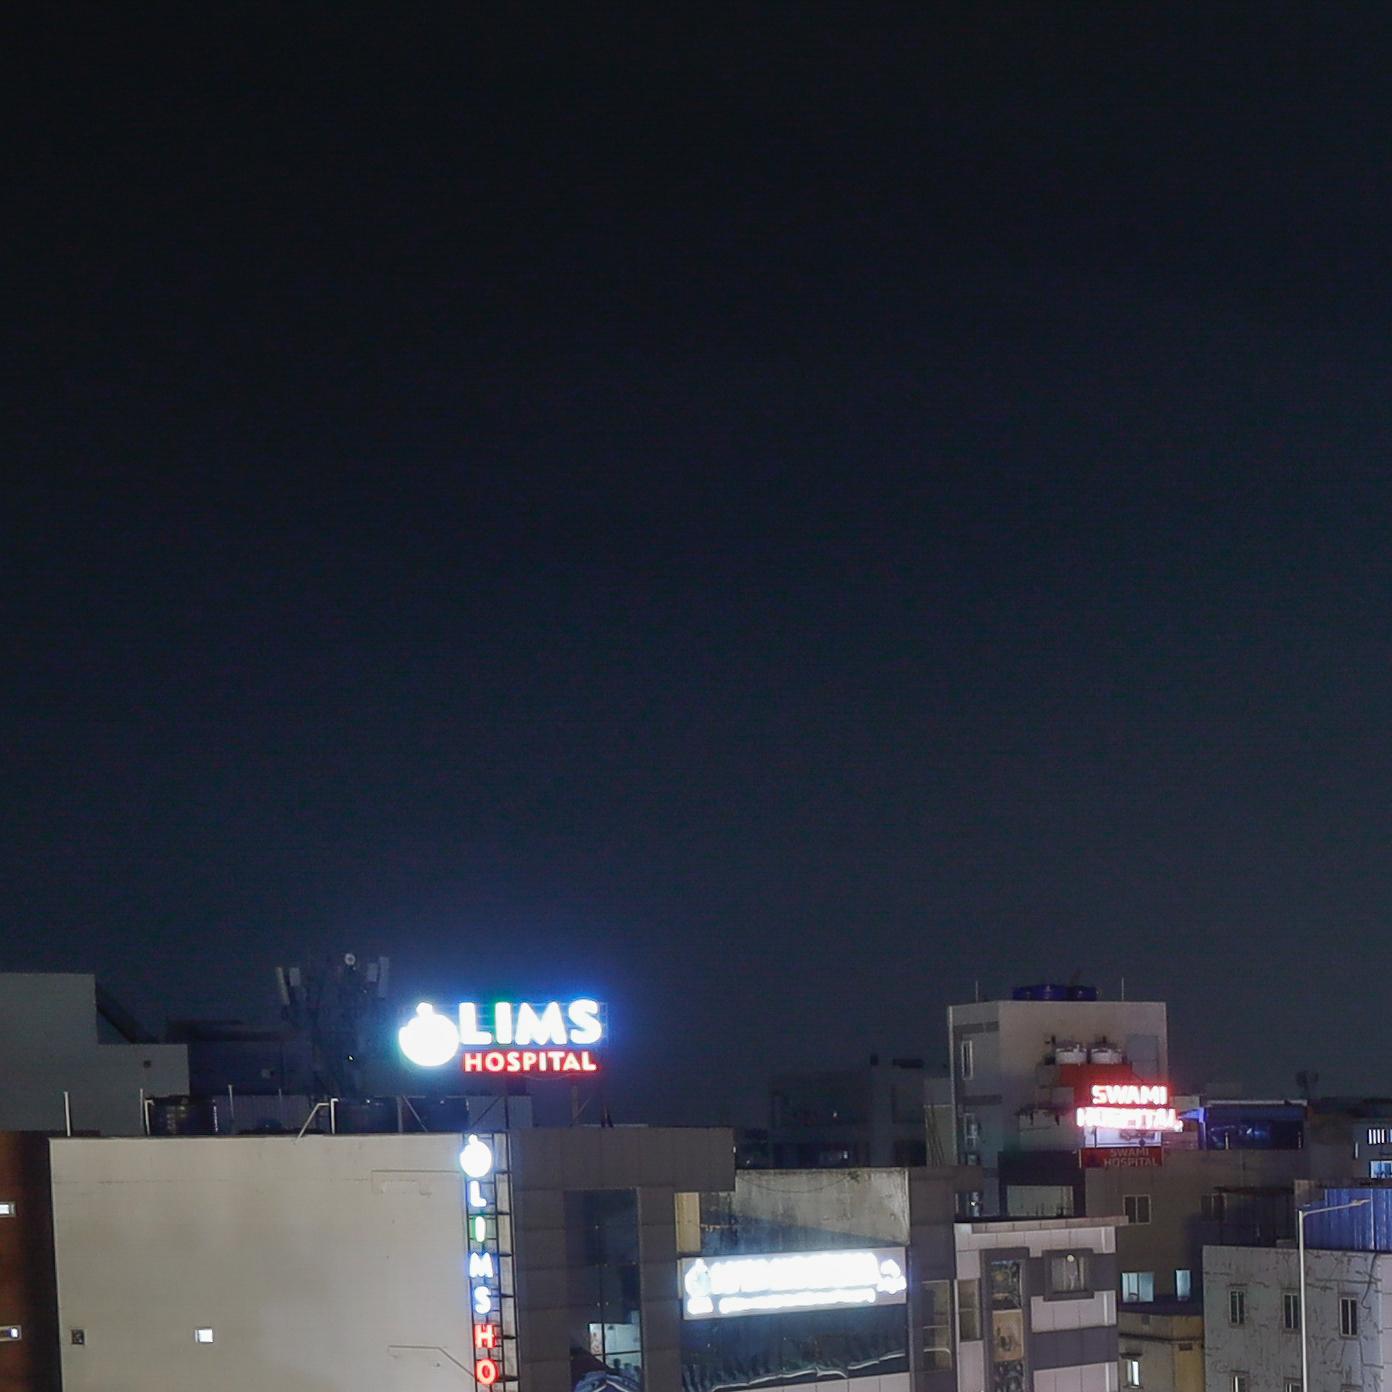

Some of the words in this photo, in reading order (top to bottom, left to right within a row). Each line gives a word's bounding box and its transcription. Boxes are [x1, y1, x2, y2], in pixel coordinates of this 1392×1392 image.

[458, 999, 602, 1045] LIMS
[464, 1051, 597, 1072] HOSPITAL
[1091, 1084, 1168, 1105] SWAMI
[469, 1180, 494, 1315] LIMS
